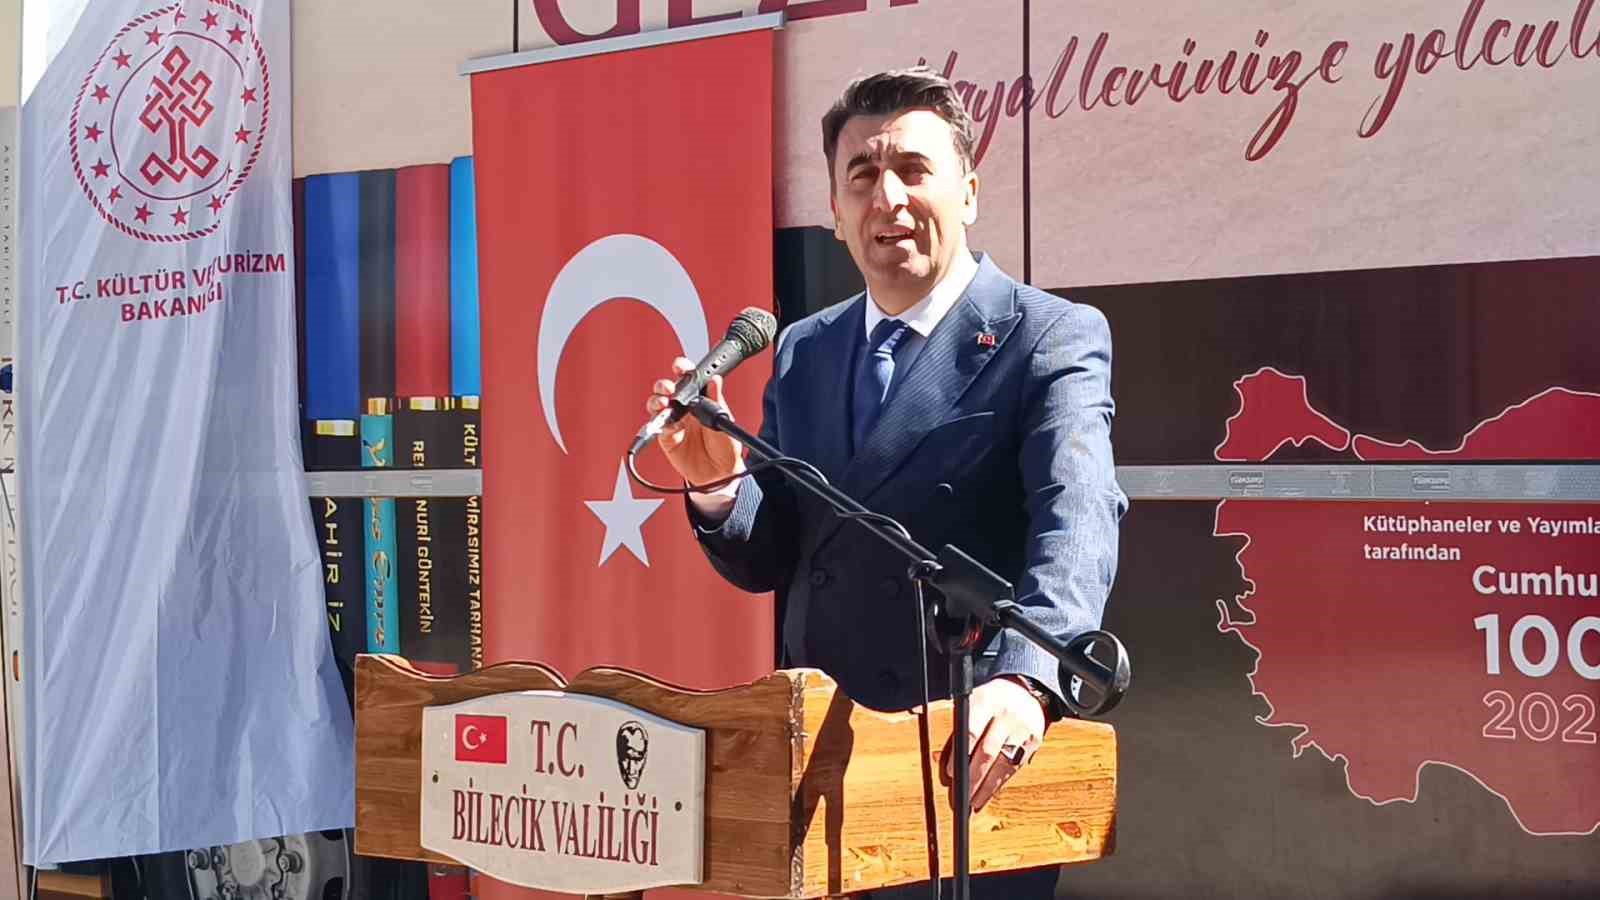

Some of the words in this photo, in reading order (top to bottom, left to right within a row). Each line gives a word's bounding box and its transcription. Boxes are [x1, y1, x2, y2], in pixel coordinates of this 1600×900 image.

[917, 30, 1348, 168] ayallerinize
[1357, 0, 1600, 138] yolcul
[56, 281, 90, 304] T.C.
[97, 268, 186, 298] KÜLTÜR
[121, 281, 222, 322] BAKANĞI
[464, 424, 479, 467] KÜLT
[325, 497, 343, 583] AHİR
[416, 500, 431, 542] NURİ
[1363, 516, 1492, 535] Kütüphaneler
[1498, 519, 1521, 533] ve
[1364, 543, 1461, 560] tarafından
[417, 546, 434, 633] GÜNTEKİN
[327, 602, 344, 632] İZ
[1474, 614, 1600, 680] 100
[530, 720, 584, 778] T.C.
[452, 777, 546, 852] BİLECİK
[552, 791, 659, 866] VALİLİĞİ
